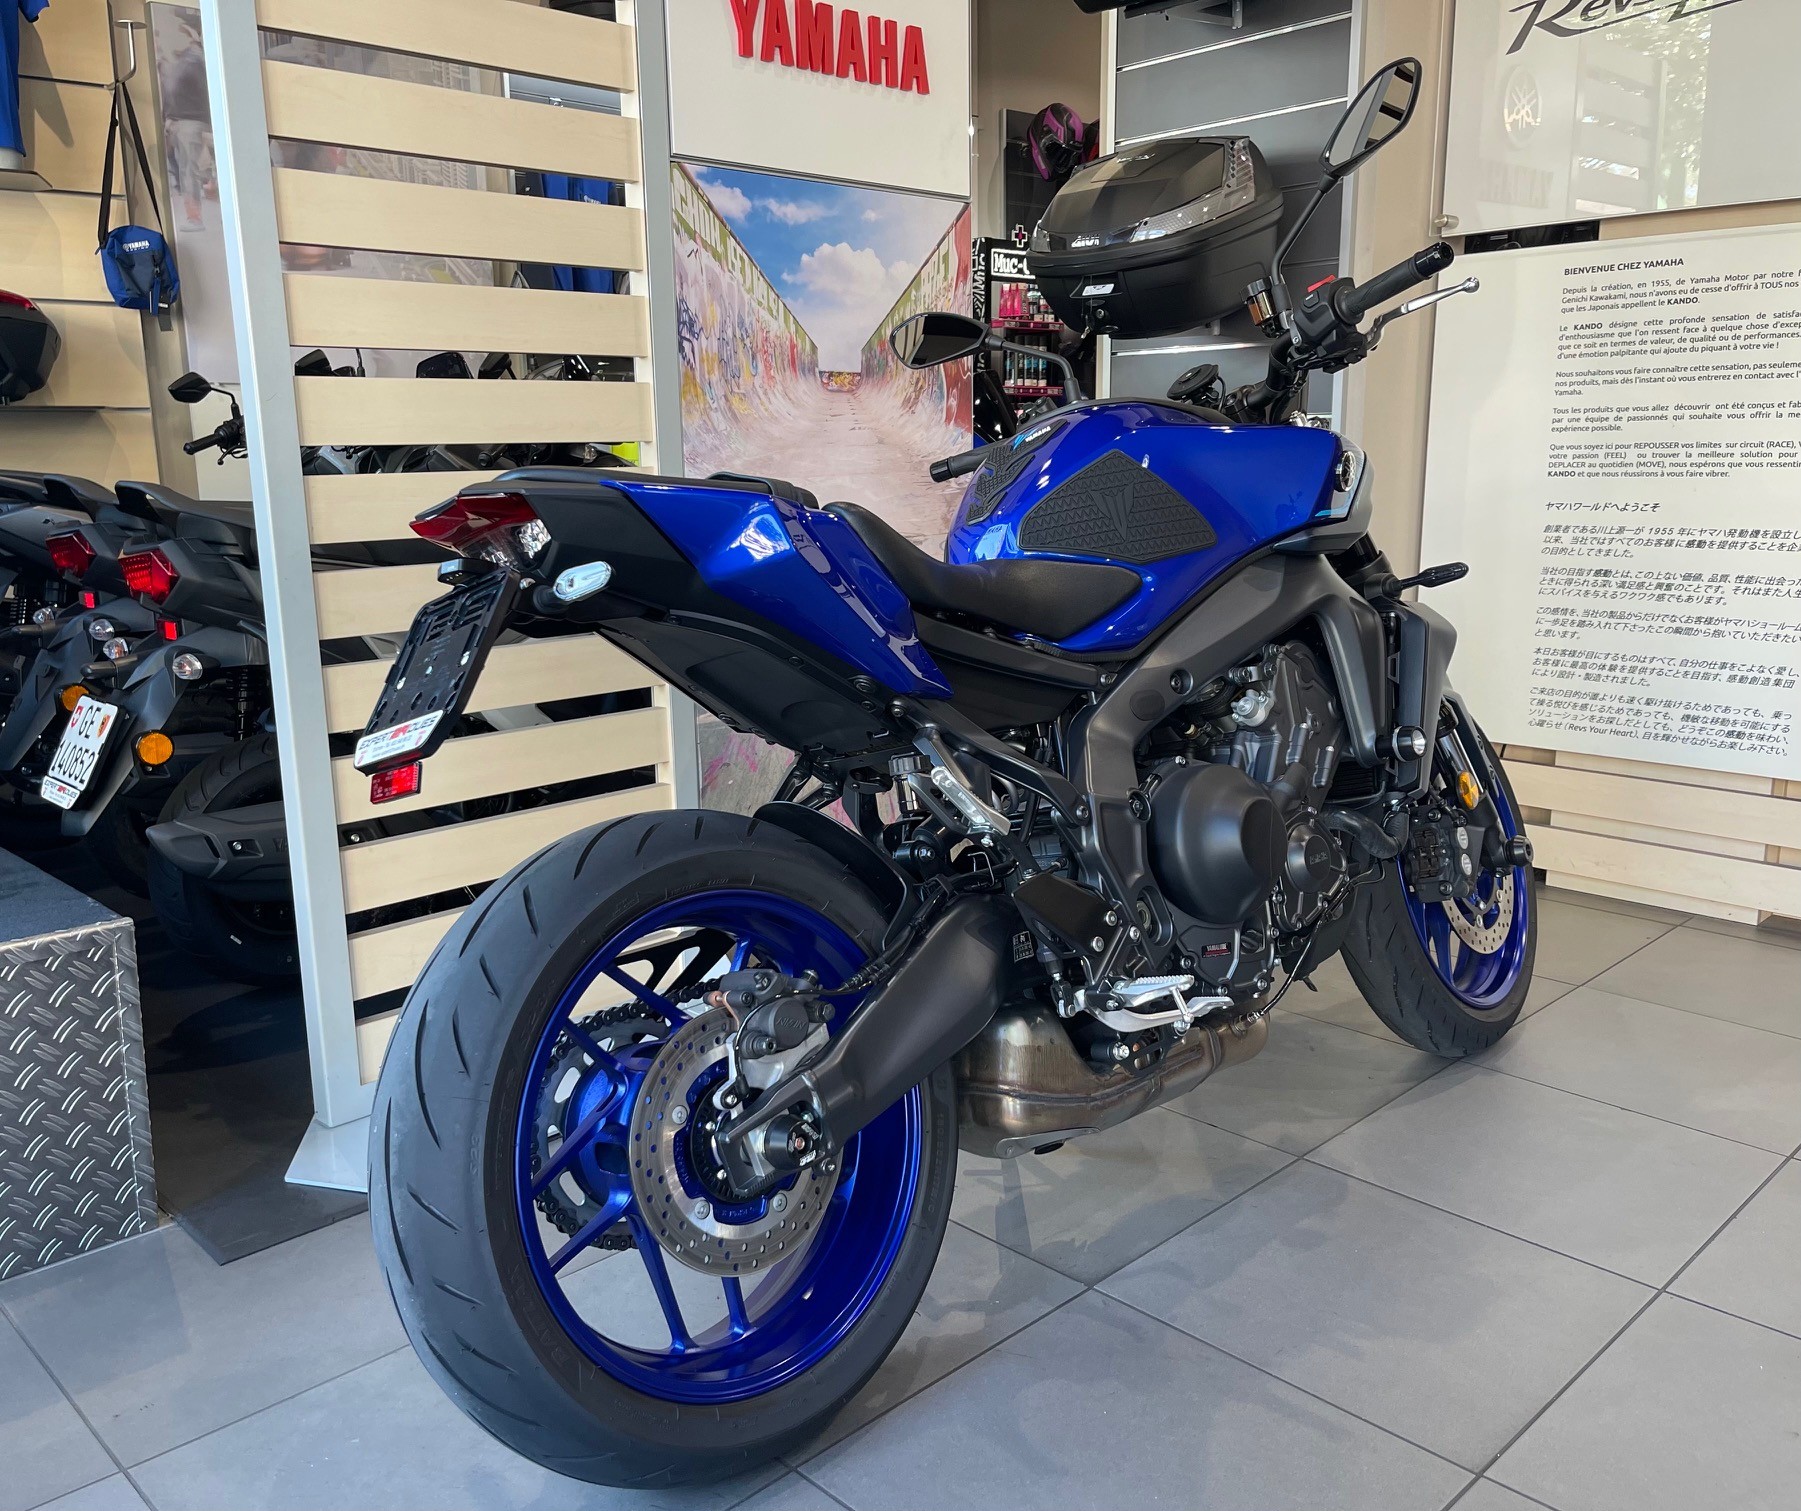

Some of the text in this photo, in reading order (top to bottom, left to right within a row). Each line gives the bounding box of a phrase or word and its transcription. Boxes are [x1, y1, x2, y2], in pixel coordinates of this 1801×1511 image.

[729, 0, 930, 95] YAMAHA
[1564, 258, 1684, 276] BIENVENUE CHEZ YAMAHA
[1562, 286, 1587, 295] Depuis
[1600, 283, 1634, 292] création,
[1651, 279, 1672, 287] 1955,
[1690, 276, 1720, 284] Yamaha
[1724, 274, 1750, 282] Motor
[1561, 295, 1588, 304] Genichi
[1589, 292, 1628, 302] Kawakami,
[1724, 283, 1753, 292] d'offrir
[1760, 281, 1783, 289] TOUS
[1588, 296, 1700, 312] Japonais appellent KANDO.
[1573, 322, 1603, 330] KANDO
[1608, 320, 1638, 329] désigne
[1669, 315, 1706, 326] profonde
[1712, 314, 1750, 322] sensation
[1558, 332, 1615, 341] d'enthousiasme
[1651, 327, 1680, 335] ressent
[1710, 324, 1743, 333] quelque
[1746, 322, 1770, 330] chose
[1650, 337, 1675, 345] valeur,
[1689, 334, 1717, 344] qualité
[1557, 352, 1577, 360] d'une
[1578, 350, 1609, 358] émotion
[1610, 349, 1648, 358] palpitante
[1662, 346, 1688, 355] ajoute
[1700, 344, 1731, 354] piquant
[1574, 369, 1614, 377] souhaitons
[1652, 365, 1689, 374] connaître
[1711, 363, 1752, 371] sensation,
[1752, 363, 1767, 371] pas
[1568, 379, 1601, 388] produits,
[1634, 376, 1665, 384] l'instant
[1744, 372, 1775, 380] contact
[1554, 388, 1584, 396] Yamaha.
[1583, 406, 1614, 414] produits
[1584, 415, 1610, 423] équipe
[1626, 414, 1668, 422] passionnés
[1672, 413, 1685, 421] qui
[1688, 412, 1723, 420] souhaite
[1551, 424, 1623, 433] expérience possible.
[1605, 442, 1614, 450] ici
[1766, 440, 1796, 449] (RACE),
[1572, 452, 1599, 460] passion
[1604, 452, 1627, 460] (FEEL)
[1697, 450, 1735, 458] meilleure
[1740, 450, 1773, 458] solution
[1598, 461, 1634, 469] quotidien
[1636, 460, 1666, 469] (MOVE),
[1689, 460, 1726, 469] espérons
[1545, 502, 1661, 512] ヤマハワールドへようこそ
[1648, 527, 1675, 535] 1955
[1541, 547, 1634, 558] の目的としてきました。
[1535, 629, 1580, 640] と思います。
[78, 705, 102, 739] GE
[1589, 725, 1608, 735] Your
[50, 739, 96, 784] 140852
